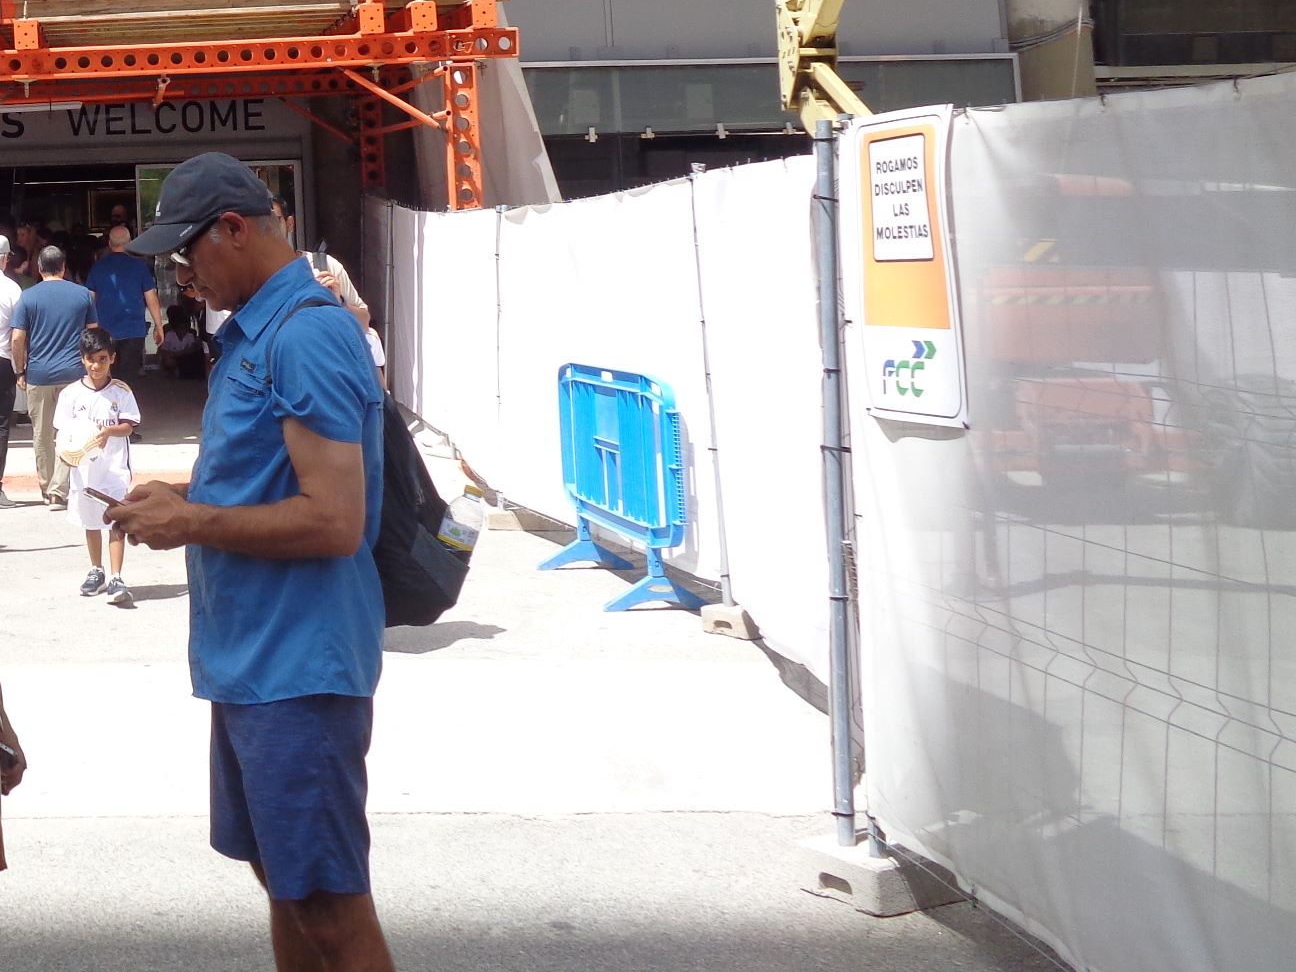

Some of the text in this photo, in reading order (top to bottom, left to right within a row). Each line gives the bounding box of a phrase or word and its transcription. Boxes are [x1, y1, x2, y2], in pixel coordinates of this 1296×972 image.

[67, 99, 266, 136] WELCOME
[876, 156, 919, 175] ROGAMOS
[874, 178, 924, 197] DISCULPEN
[892, 202, 910, 217] LAS
[876, 223, 929, 240] MOLESTIAS
[882, 359, 925, 398] FCC
